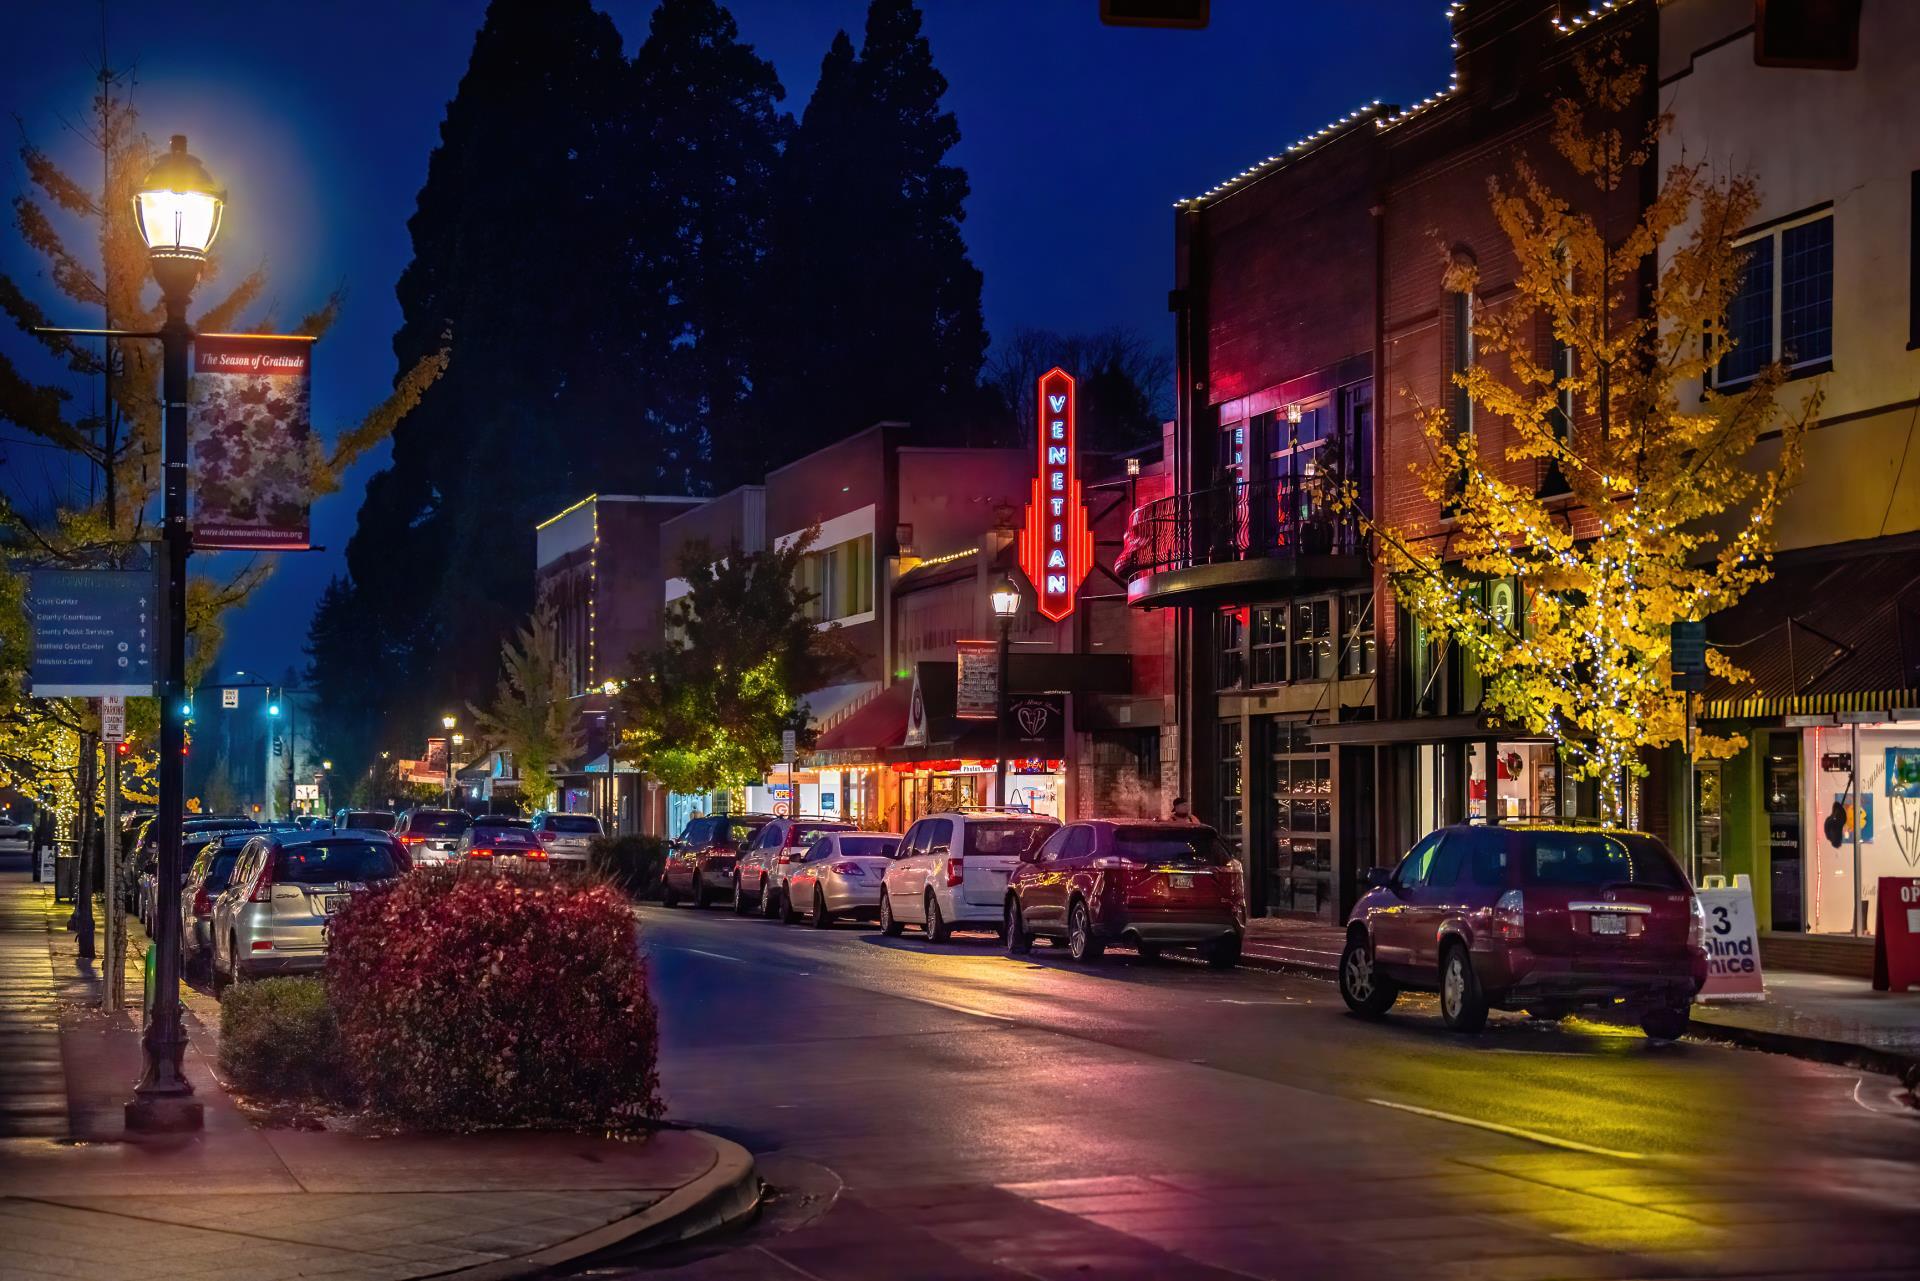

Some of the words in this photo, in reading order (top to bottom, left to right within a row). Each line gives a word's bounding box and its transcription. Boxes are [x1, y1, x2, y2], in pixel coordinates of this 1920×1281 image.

[201, 353, 218, 365] The
[220, 354, 249, 366] Season
[251, 355, 262, 369] of
[262, 355, 304, 367] Gratitude
[1048, 395, 1066, 593] VENETIAN
[104, 704, 123, 715] PARKING
[105, 715, 122, 723] LOADING
[1712, 906, 1731, 935] 3
